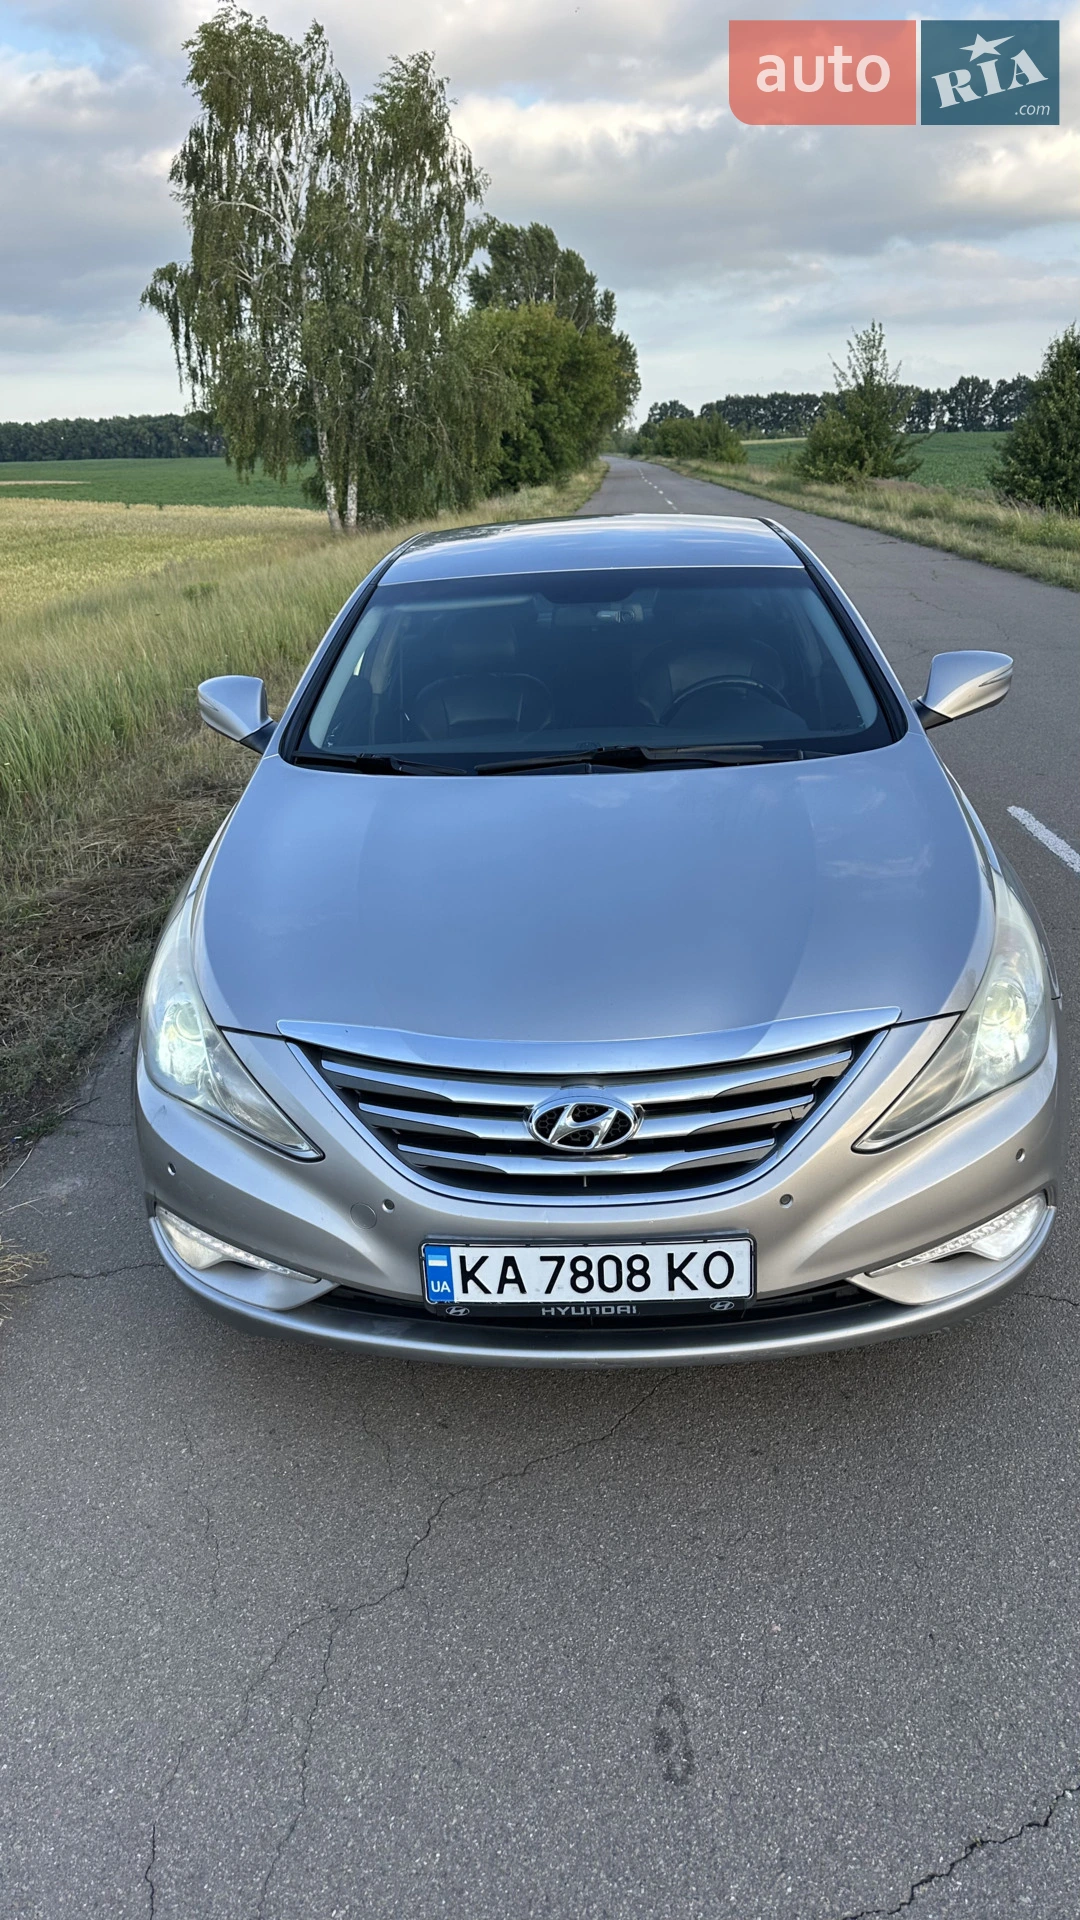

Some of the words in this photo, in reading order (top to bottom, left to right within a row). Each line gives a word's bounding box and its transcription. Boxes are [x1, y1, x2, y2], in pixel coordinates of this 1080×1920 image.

[459, 1255, 526, 1295] KA
[539, 1254, 651, 1295] 7808
[667, 1250, 735, 1292] KO
[431, 1280, 451, 1294] UA
[541, 1305, 637, 1316] HYUNDAI
